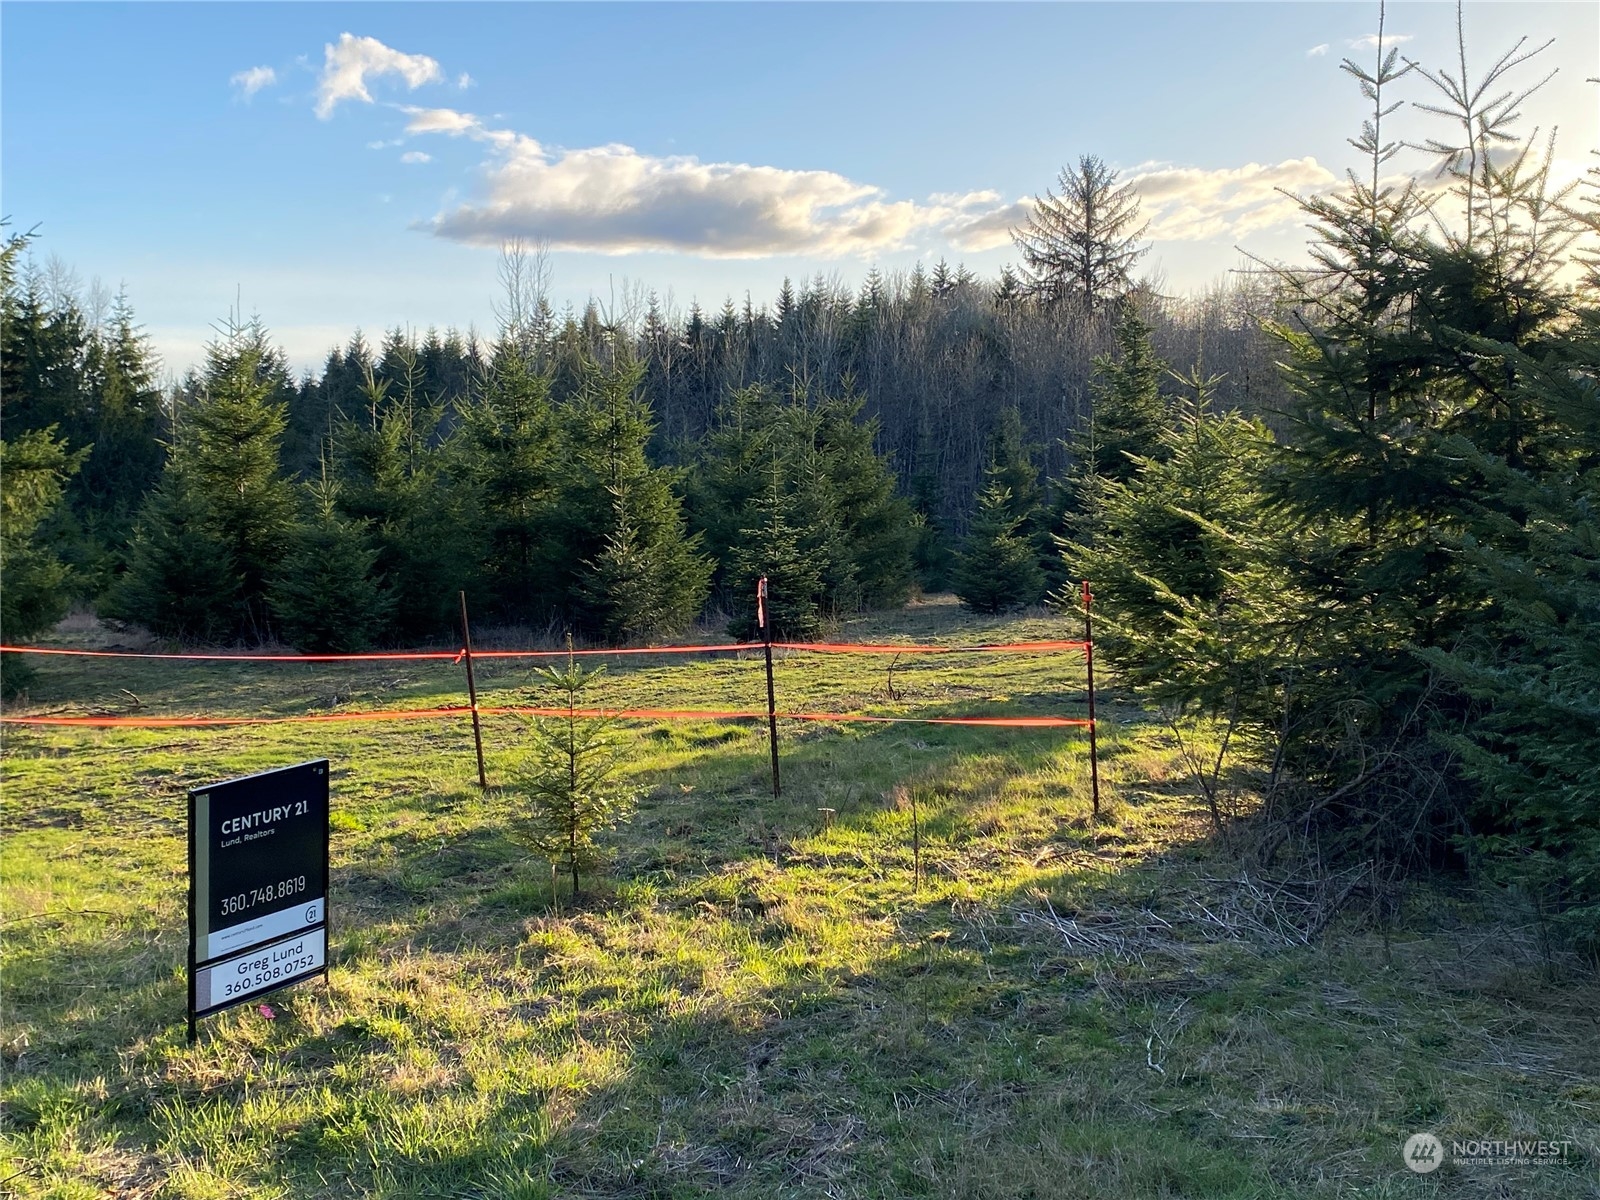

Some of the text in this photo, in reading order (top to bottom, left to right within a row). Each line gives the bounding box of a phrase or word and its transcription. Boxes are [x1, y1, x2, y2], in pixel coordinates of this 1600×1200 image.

[221, 800, 307, 835] CENTURY 21
[221, 828, 275, 848] Lund, Realtors
[221, 875, 306, 916] 360.748.8619
[225, 954, 314, 997] 360.508.0752
[237, 956, 269, 975] Greg
[273, 941, 303, 963] Lund
